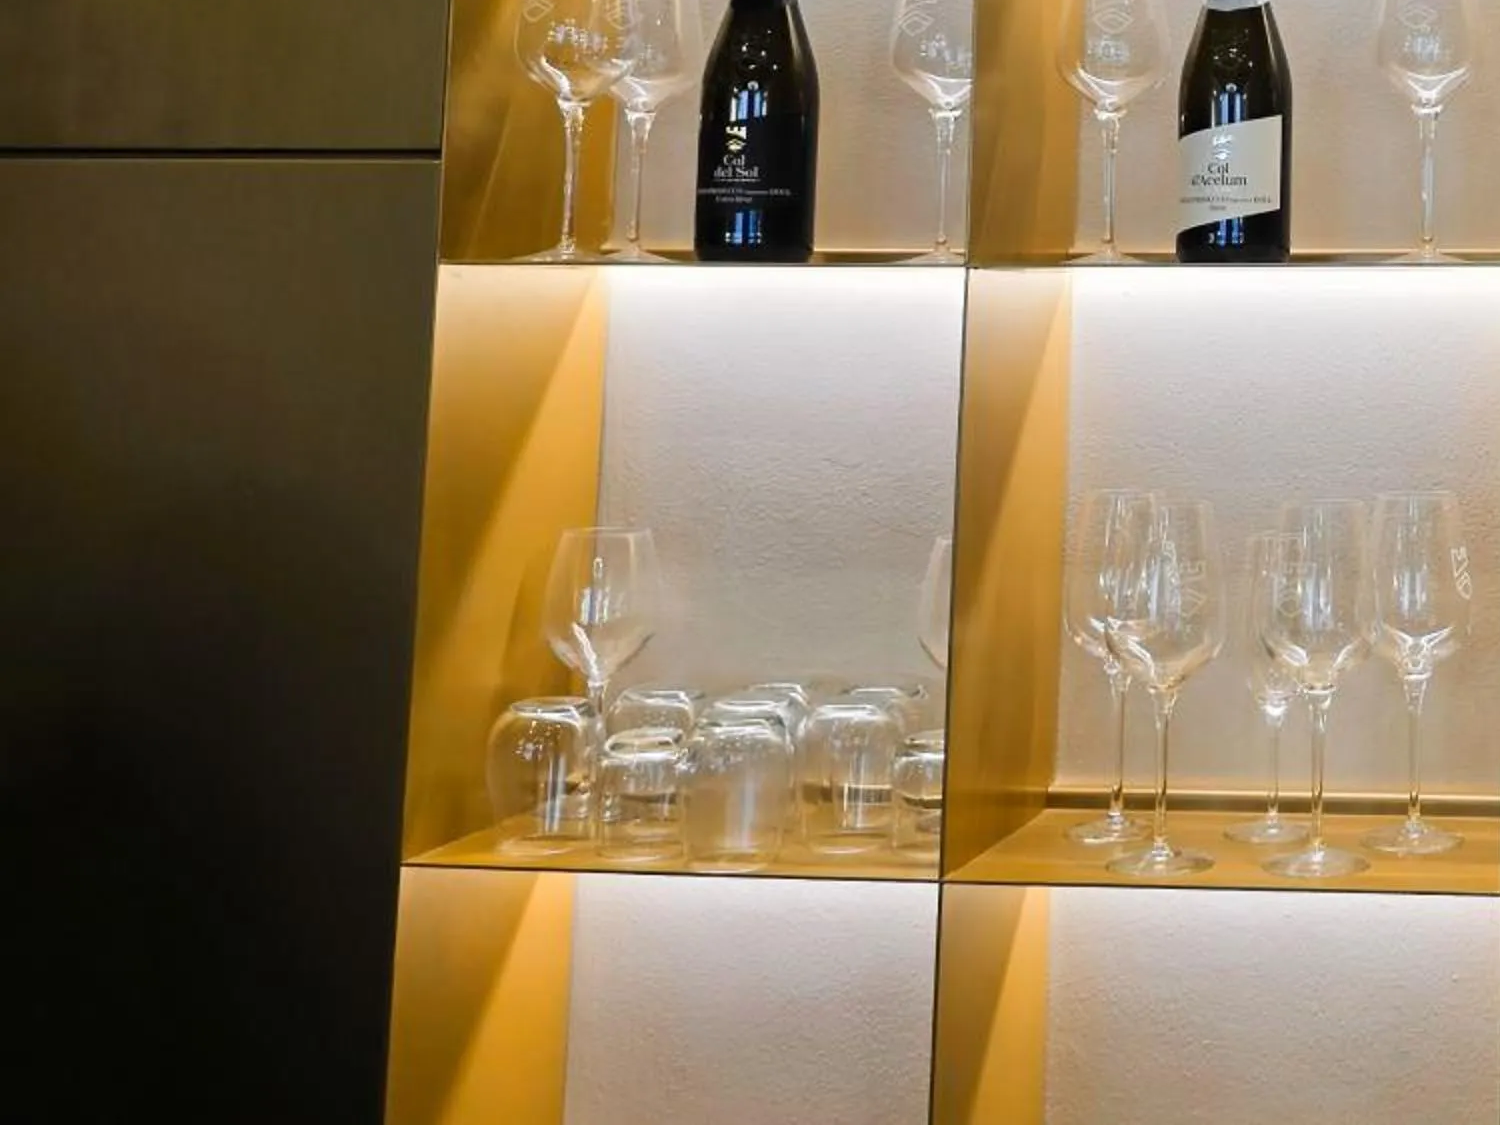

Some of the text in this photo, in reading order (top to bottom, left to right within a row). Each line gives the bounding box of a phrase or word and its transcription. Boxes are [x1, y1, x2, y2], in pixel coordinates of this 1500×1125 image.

[723, 154, 745, 166] Col
[714, 166, 759, 178] del Sol
[1207, 161, 1230, 175] Col
